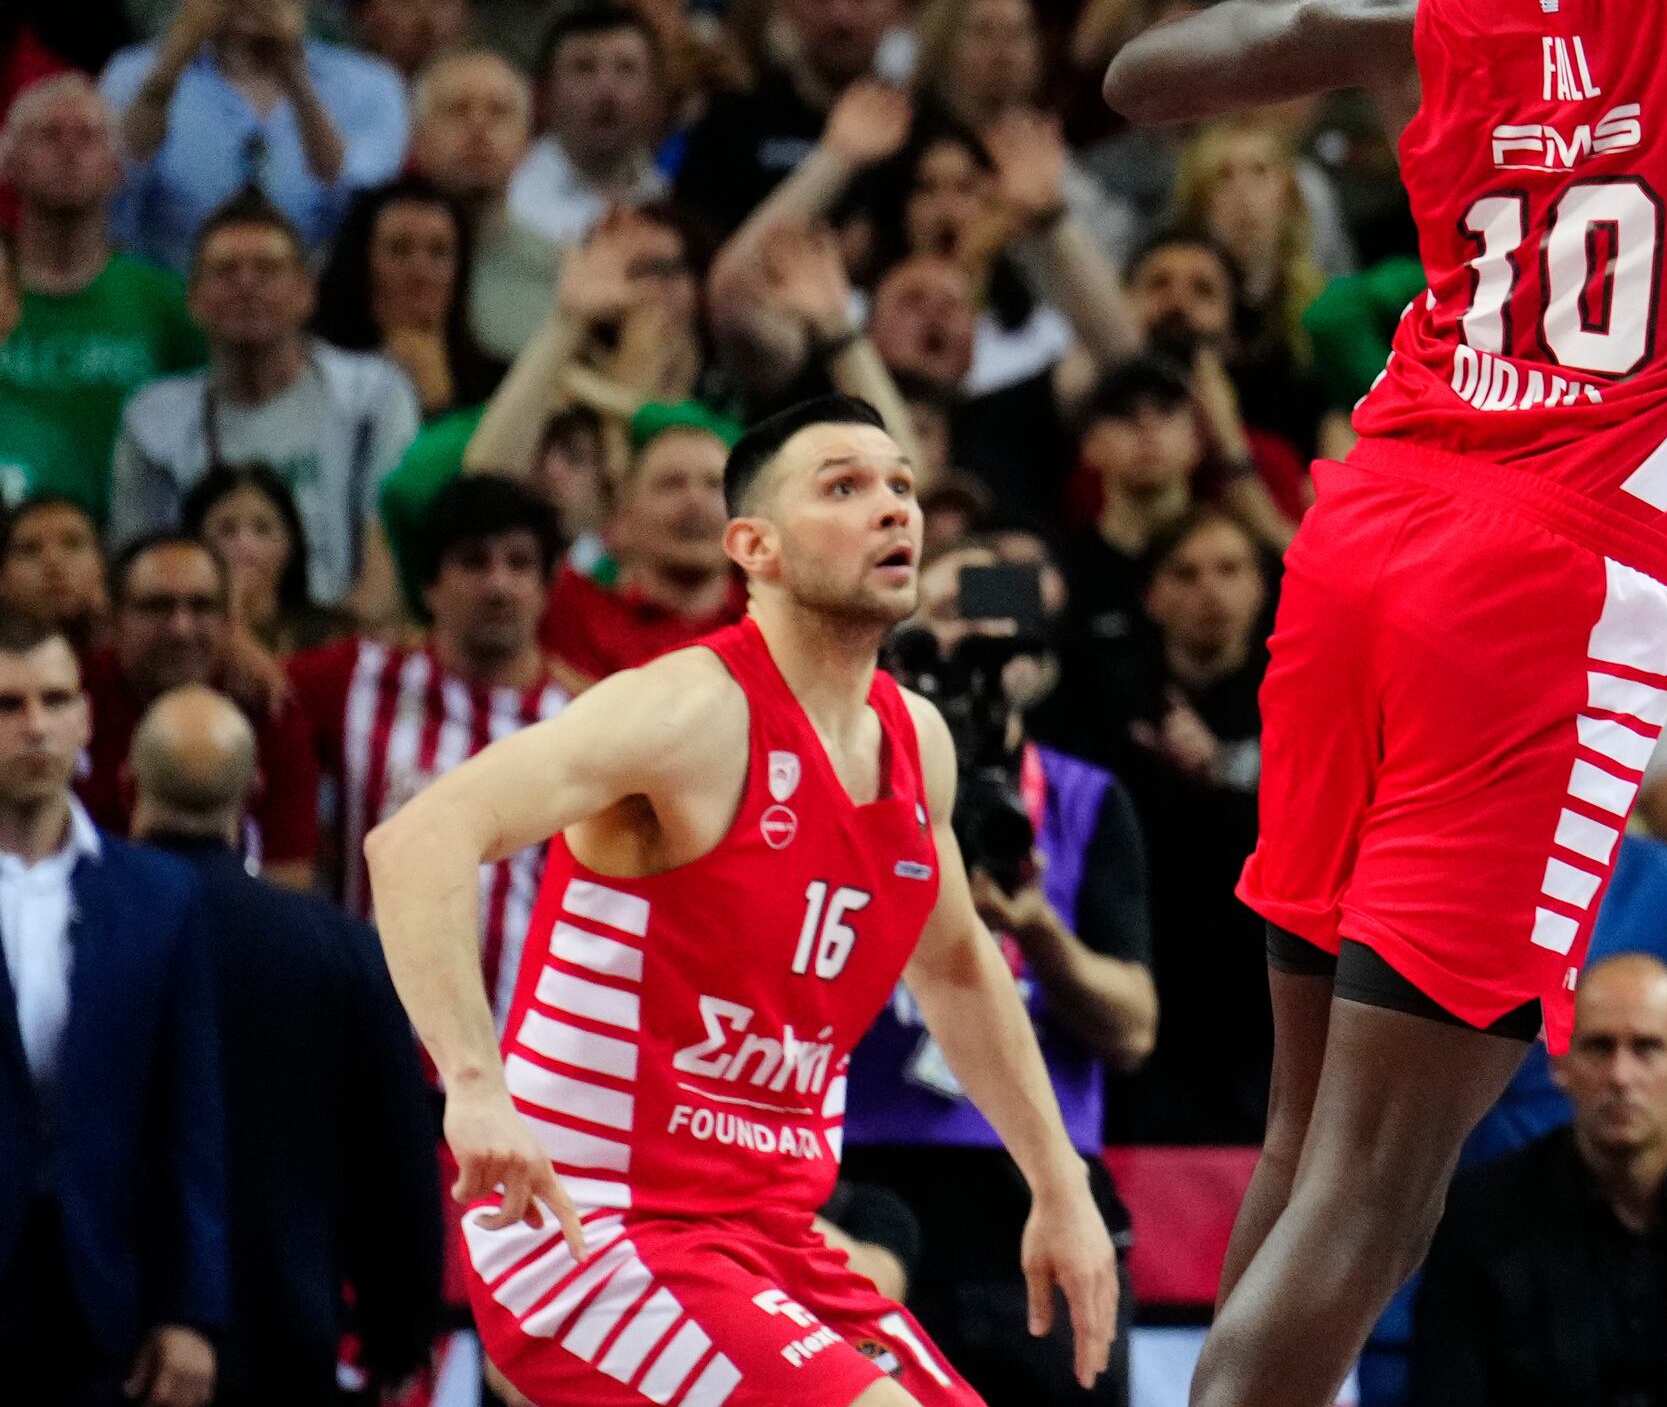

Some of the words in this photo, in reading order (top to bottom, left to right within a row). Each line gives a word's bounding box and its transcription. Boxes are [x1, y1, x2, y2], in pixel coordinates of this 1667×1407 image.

[1542, 35, 1601, 101] FALL
[1491, 102, 1642, 171] FMS
[1457, 174, 1665, 378] 10
[791, 878, 871, 981] 16
